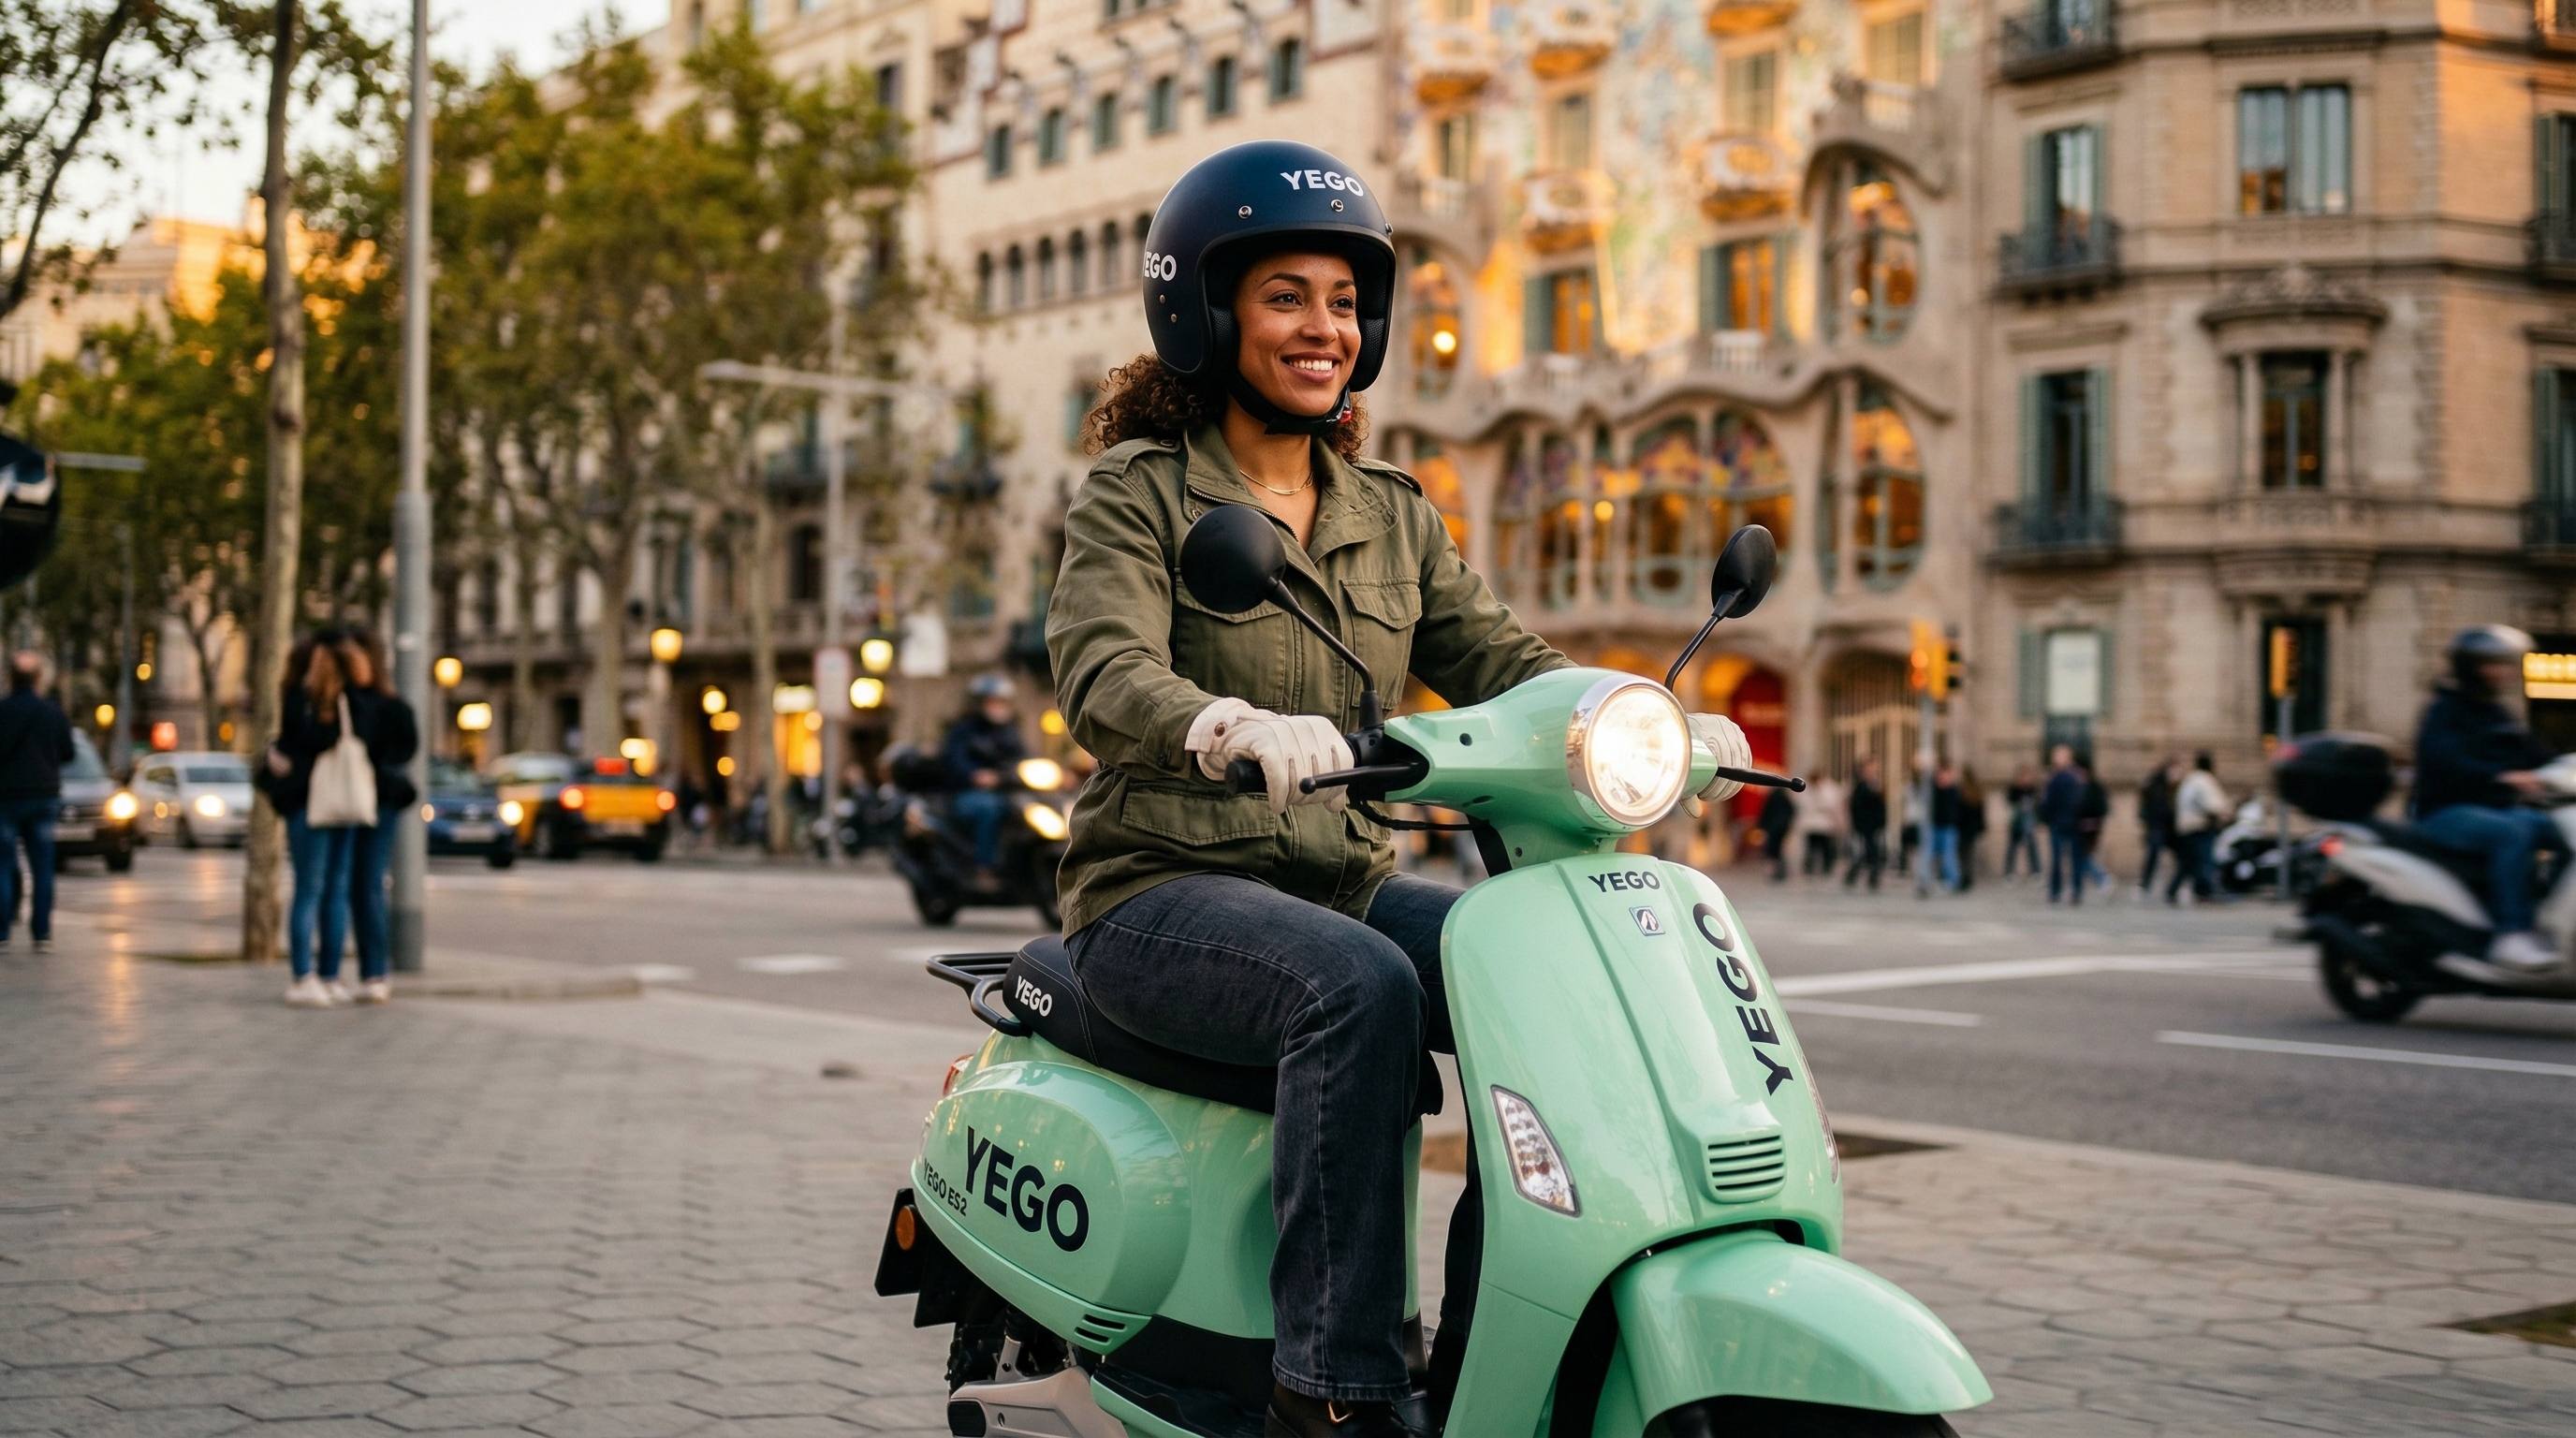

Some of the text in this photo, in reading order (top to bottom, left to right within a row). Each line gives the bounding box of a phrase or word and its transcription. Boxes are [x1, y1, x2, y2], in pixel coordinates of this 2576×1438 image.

[1281, 169, 1364, 197] YEGO
[1144, 251, 1177, 281] EGO
[1588, 871, 1661, 892] YEGO
[1015, 975, 1053, 1017] YEGO
[1692, 902, 1794, 1096] YEGO
[947, 1186, 968, 1217] ES2
[965, 1125, 1090, 1253] YEGO
